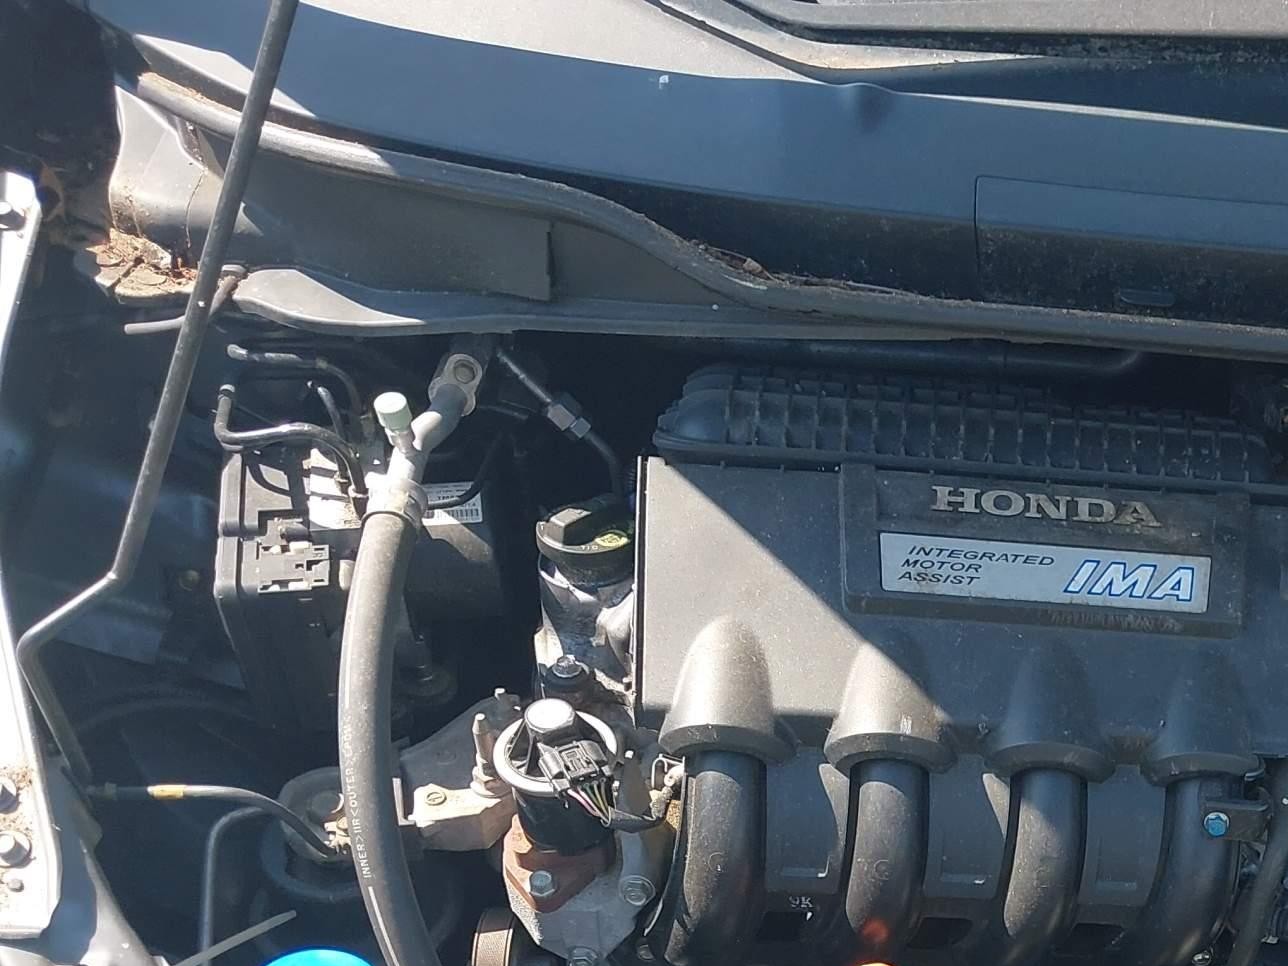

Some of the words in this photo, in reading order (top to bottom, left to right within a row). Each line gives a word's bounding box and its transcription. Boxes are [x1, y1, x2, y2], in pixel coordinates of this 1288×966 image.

[931, 485, 1162, 528] HONDA
[901, 557, 983, 574] MOTOR
[907, 545, 1055, 567] INTEGRATED
[898, 571, 981, 587] ASSIST
[1063, 559, 1197, 602] IMA
